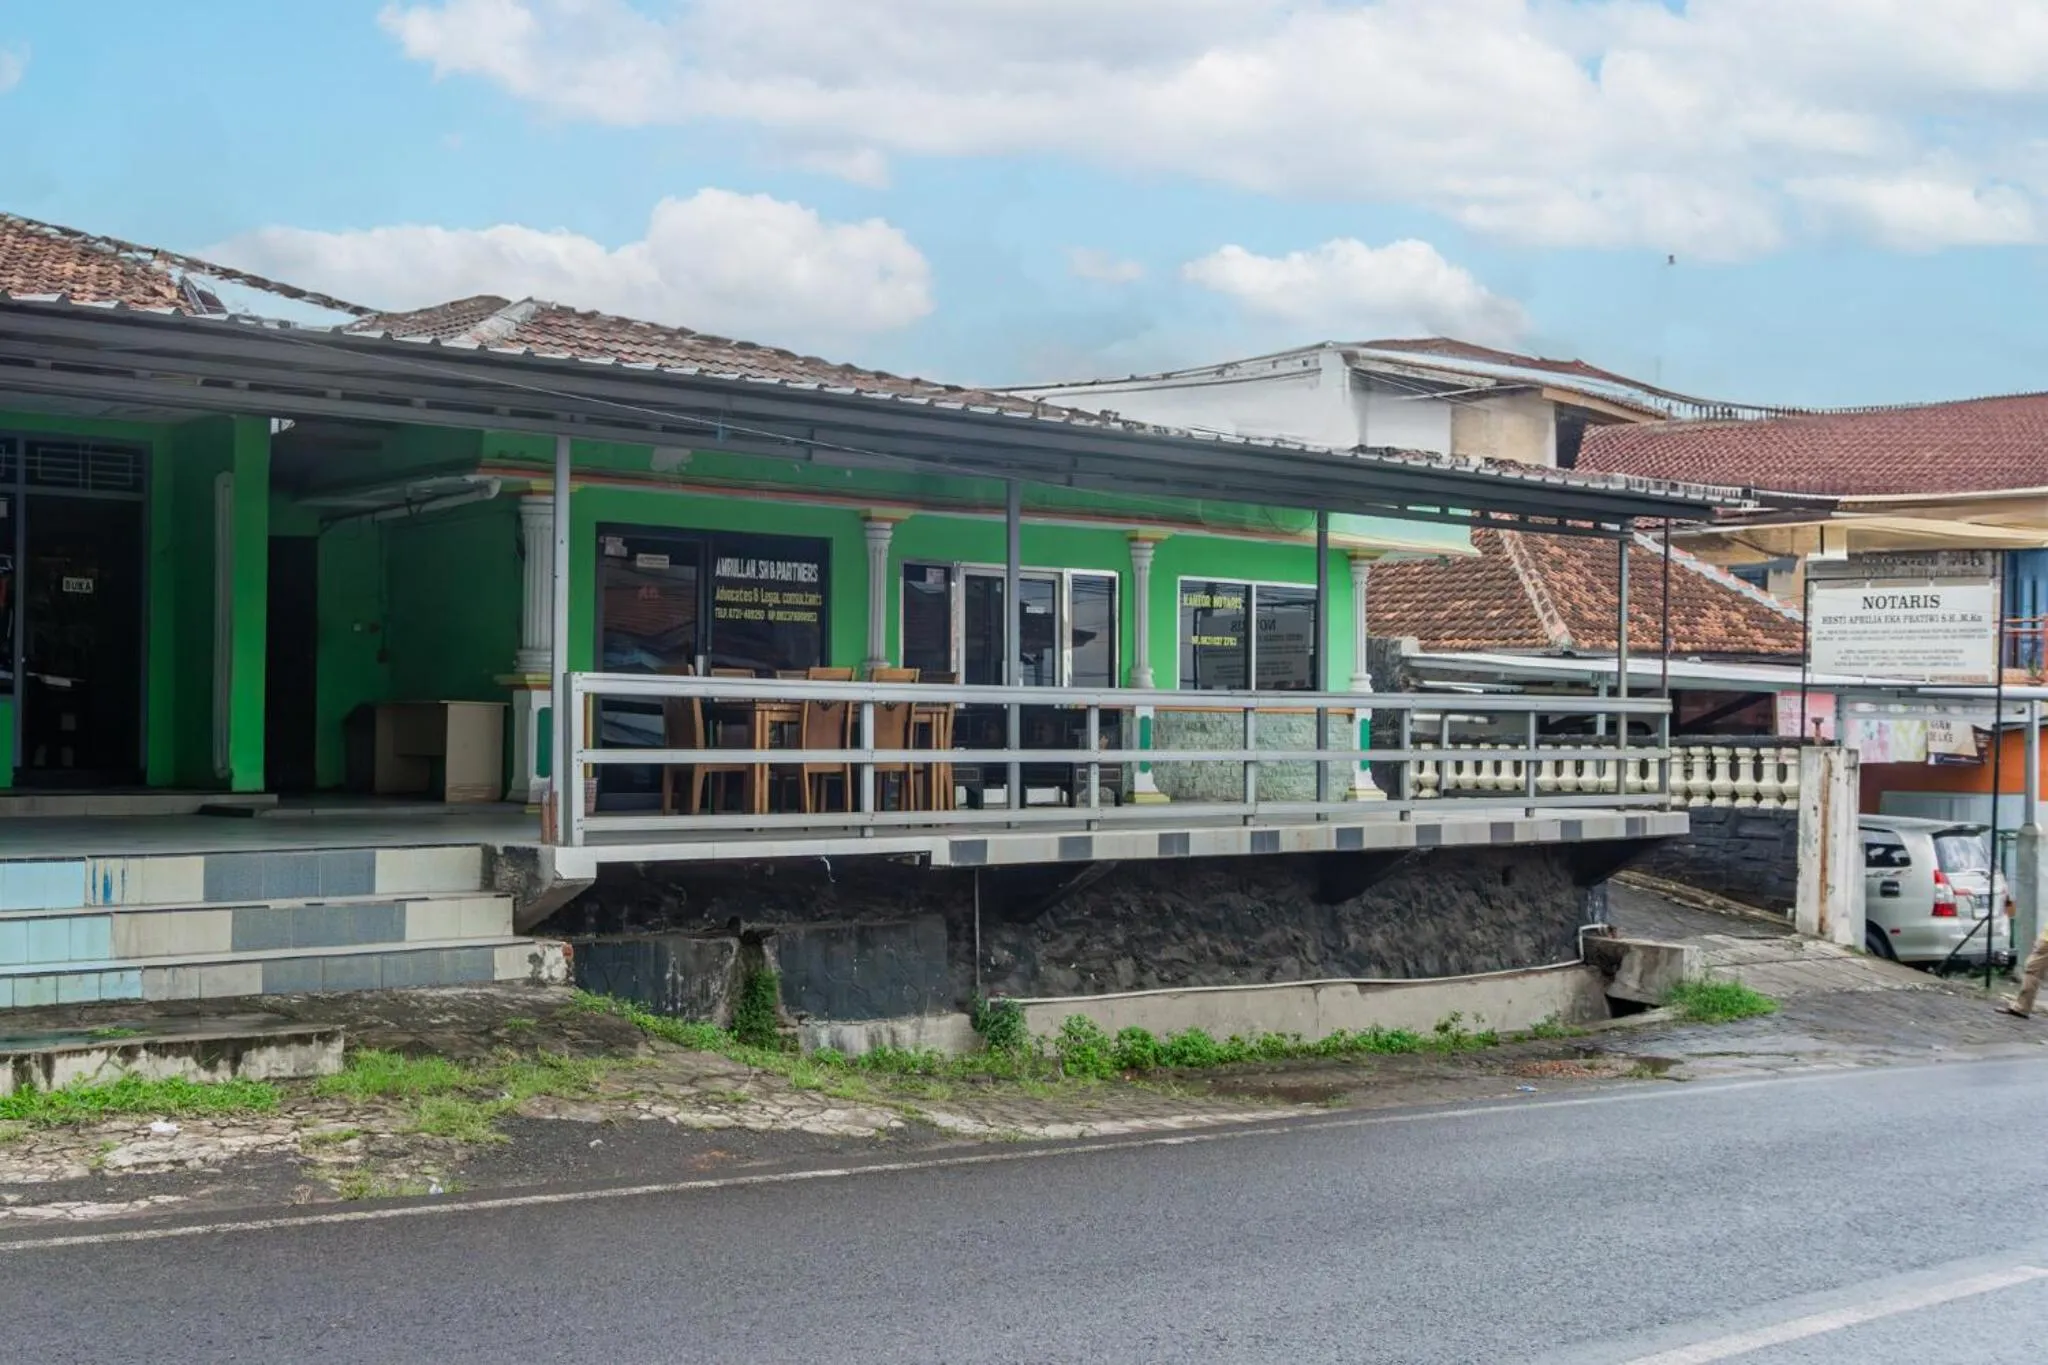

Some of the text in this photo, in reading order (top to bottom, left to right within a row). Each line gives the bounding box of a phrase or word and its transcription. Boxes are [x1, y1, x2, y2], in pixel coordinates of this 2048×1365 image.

[777, 561, 818, 582] PARTNERS
[1862, 595, 1941, 609] NOTARIS
[1849, 615, 1882, 625] APRILIA
[1884, 615, 1902, 624] EKA
[1903, 614, 1939, 624] PRATIWI
